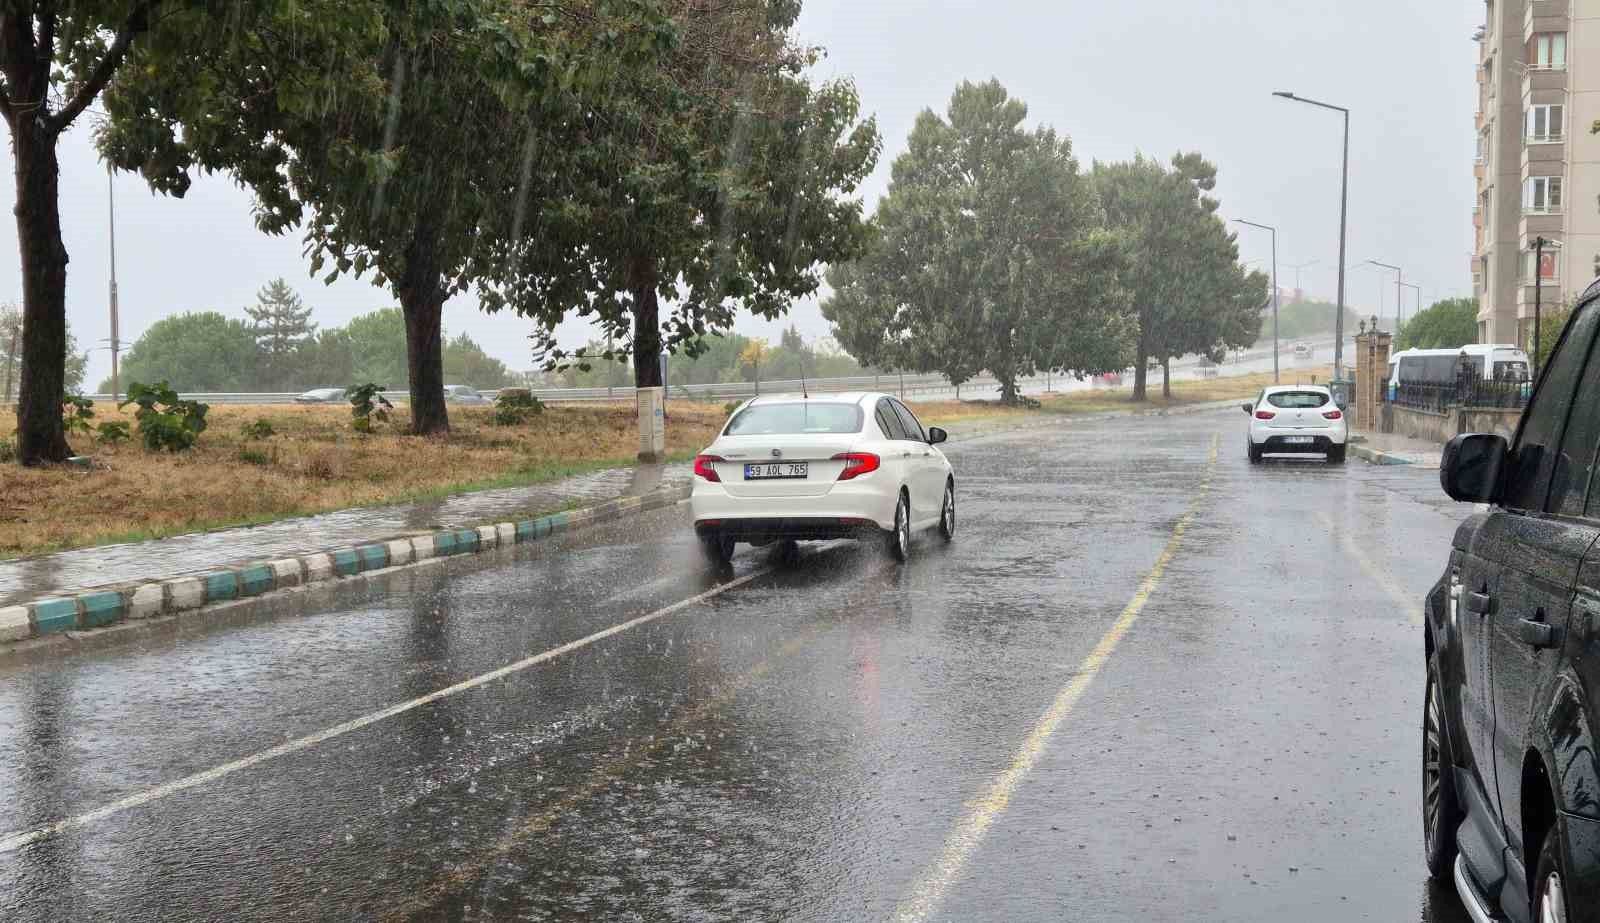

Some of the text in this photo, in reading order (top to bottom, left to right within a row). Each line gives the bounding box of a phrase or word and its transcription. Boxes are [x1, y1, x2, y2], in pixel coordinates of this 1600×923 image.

[751, 464, 805, 475] 59 AOL 765
